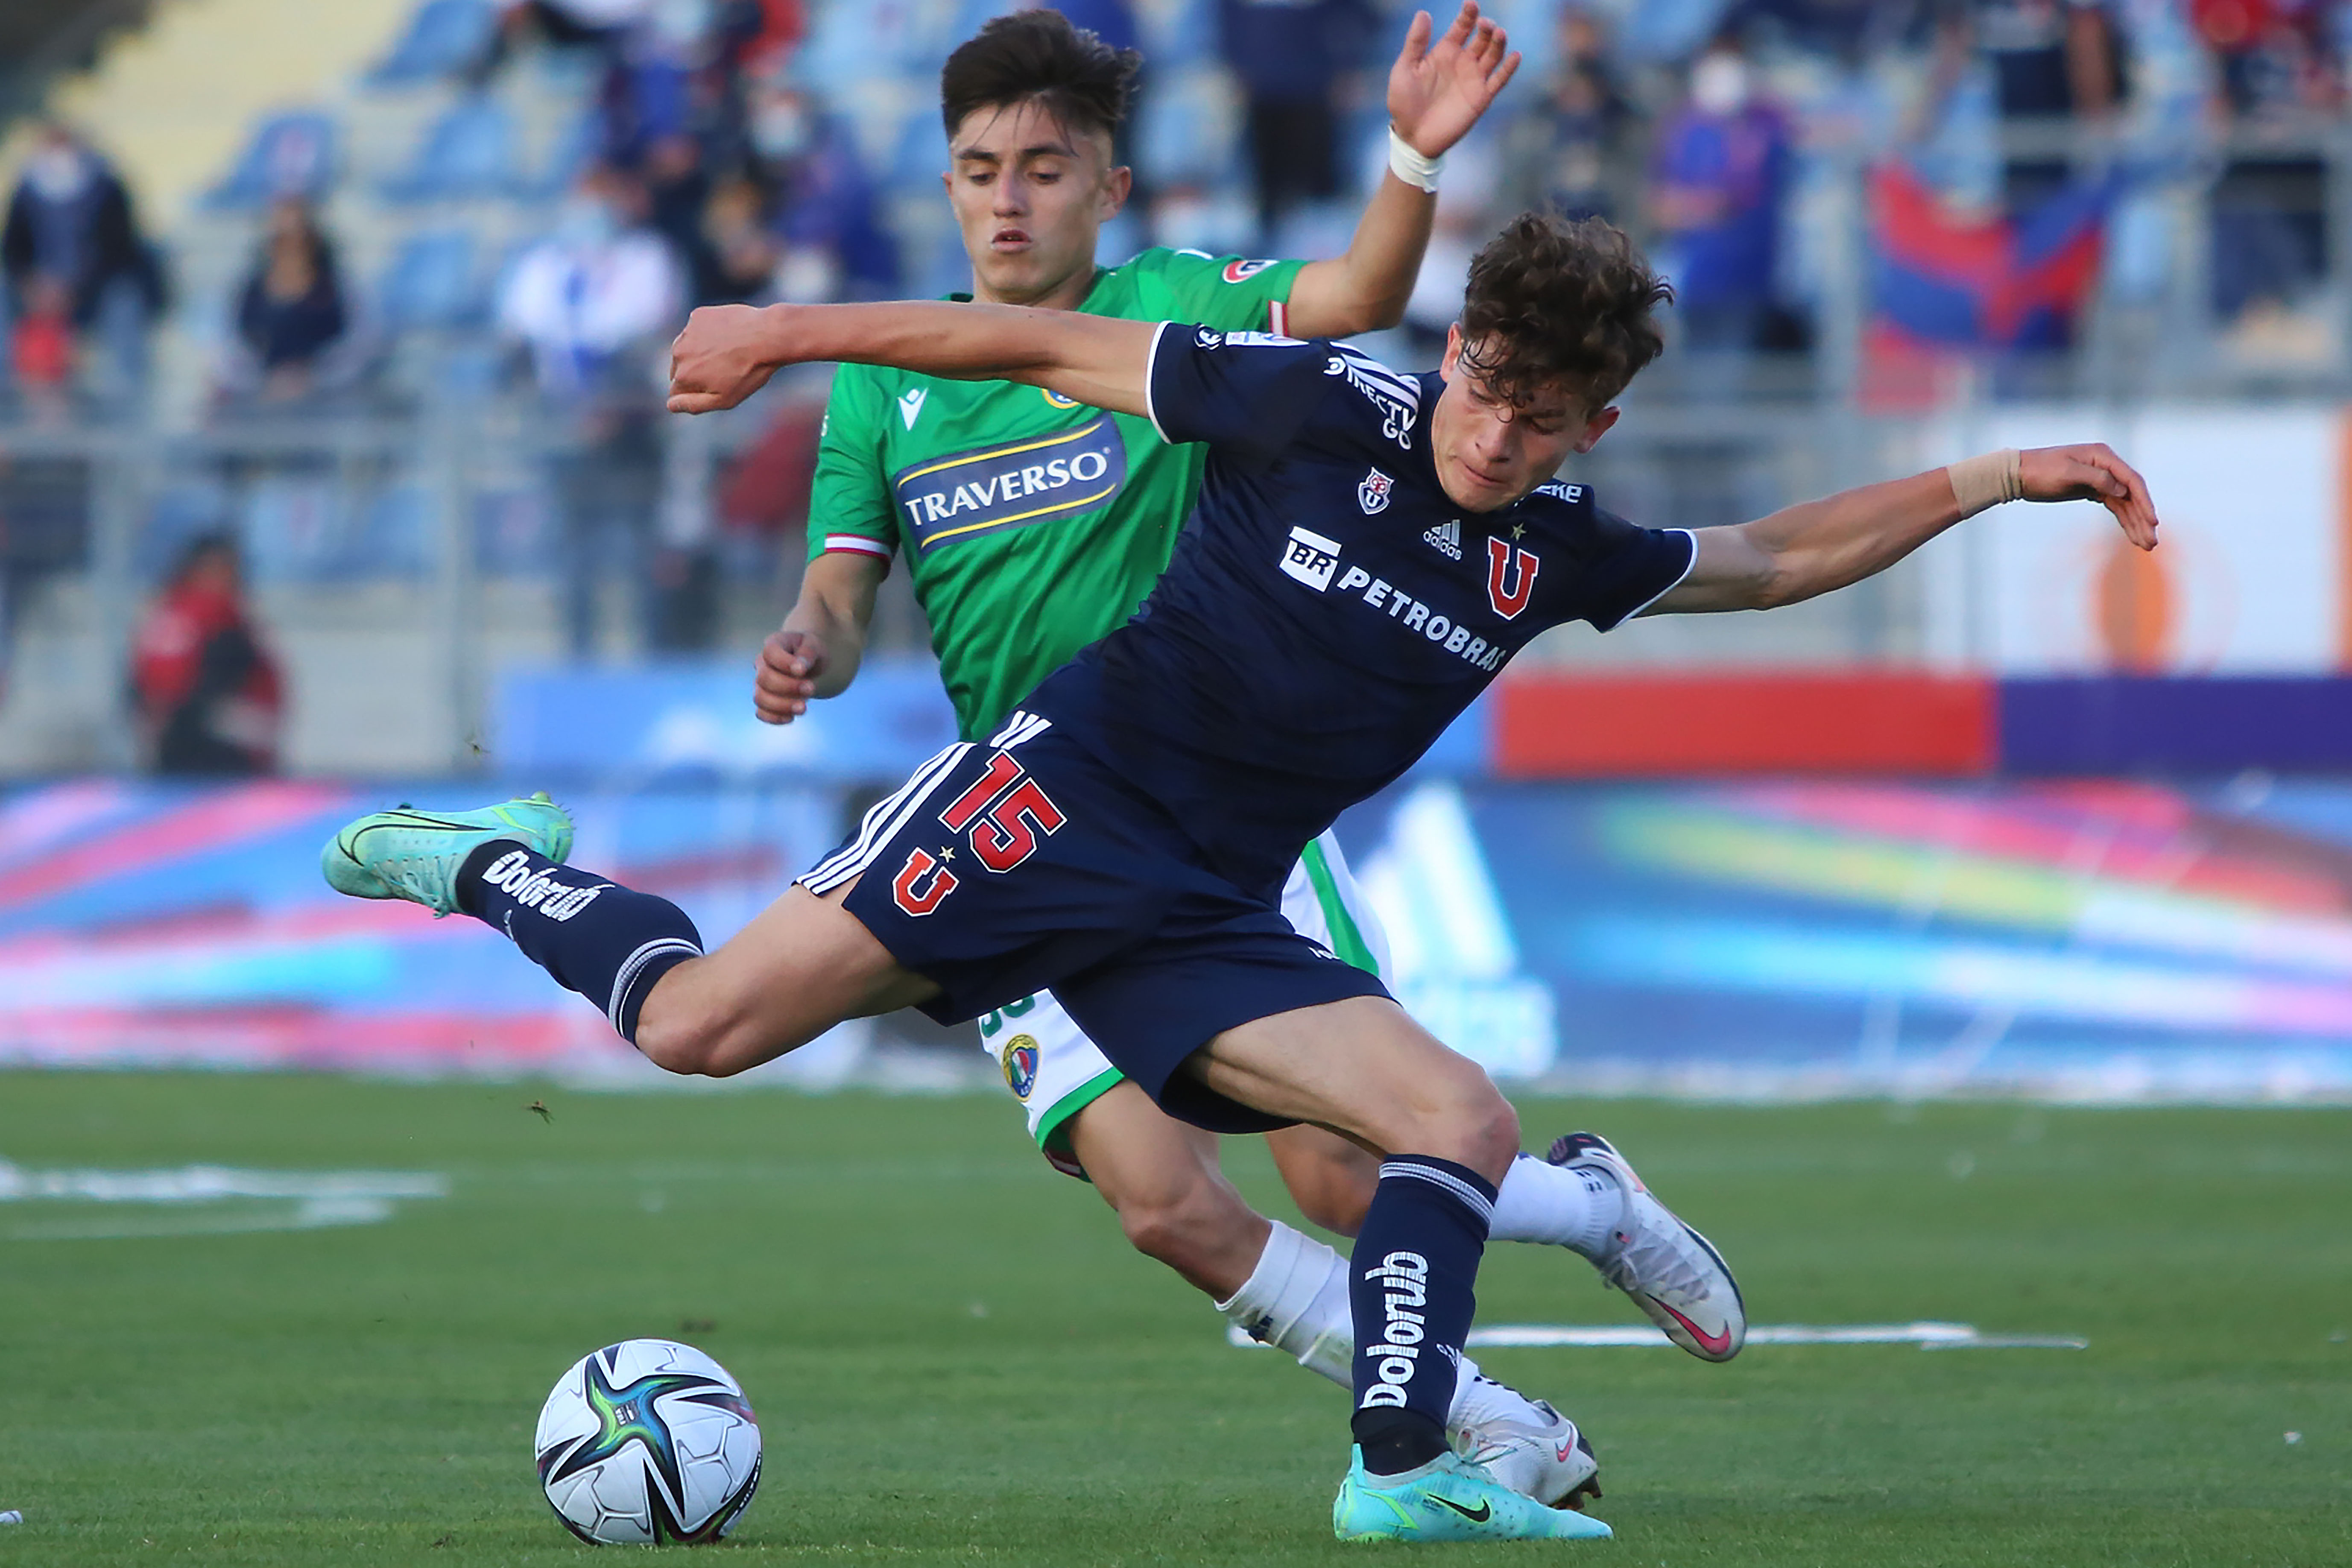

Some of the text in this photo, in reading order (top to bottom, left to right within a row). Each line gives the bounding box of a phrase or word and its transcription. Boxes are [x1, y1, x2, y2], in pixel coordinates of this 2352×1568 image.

[1383, 418, 1411, 450] GO
[905, 452, 1107, 526] TRAVERSO
[1423, 531, 1462, 560] adidas
[1488, 535, 1539, 620] U
[1290, 547, 1507, 672] BR PETROBRAS
[938, 749, 1068, 874] 15
[892, 847, 960, 916] U
[1359, 1251, 1429, 1409] Dolorub
